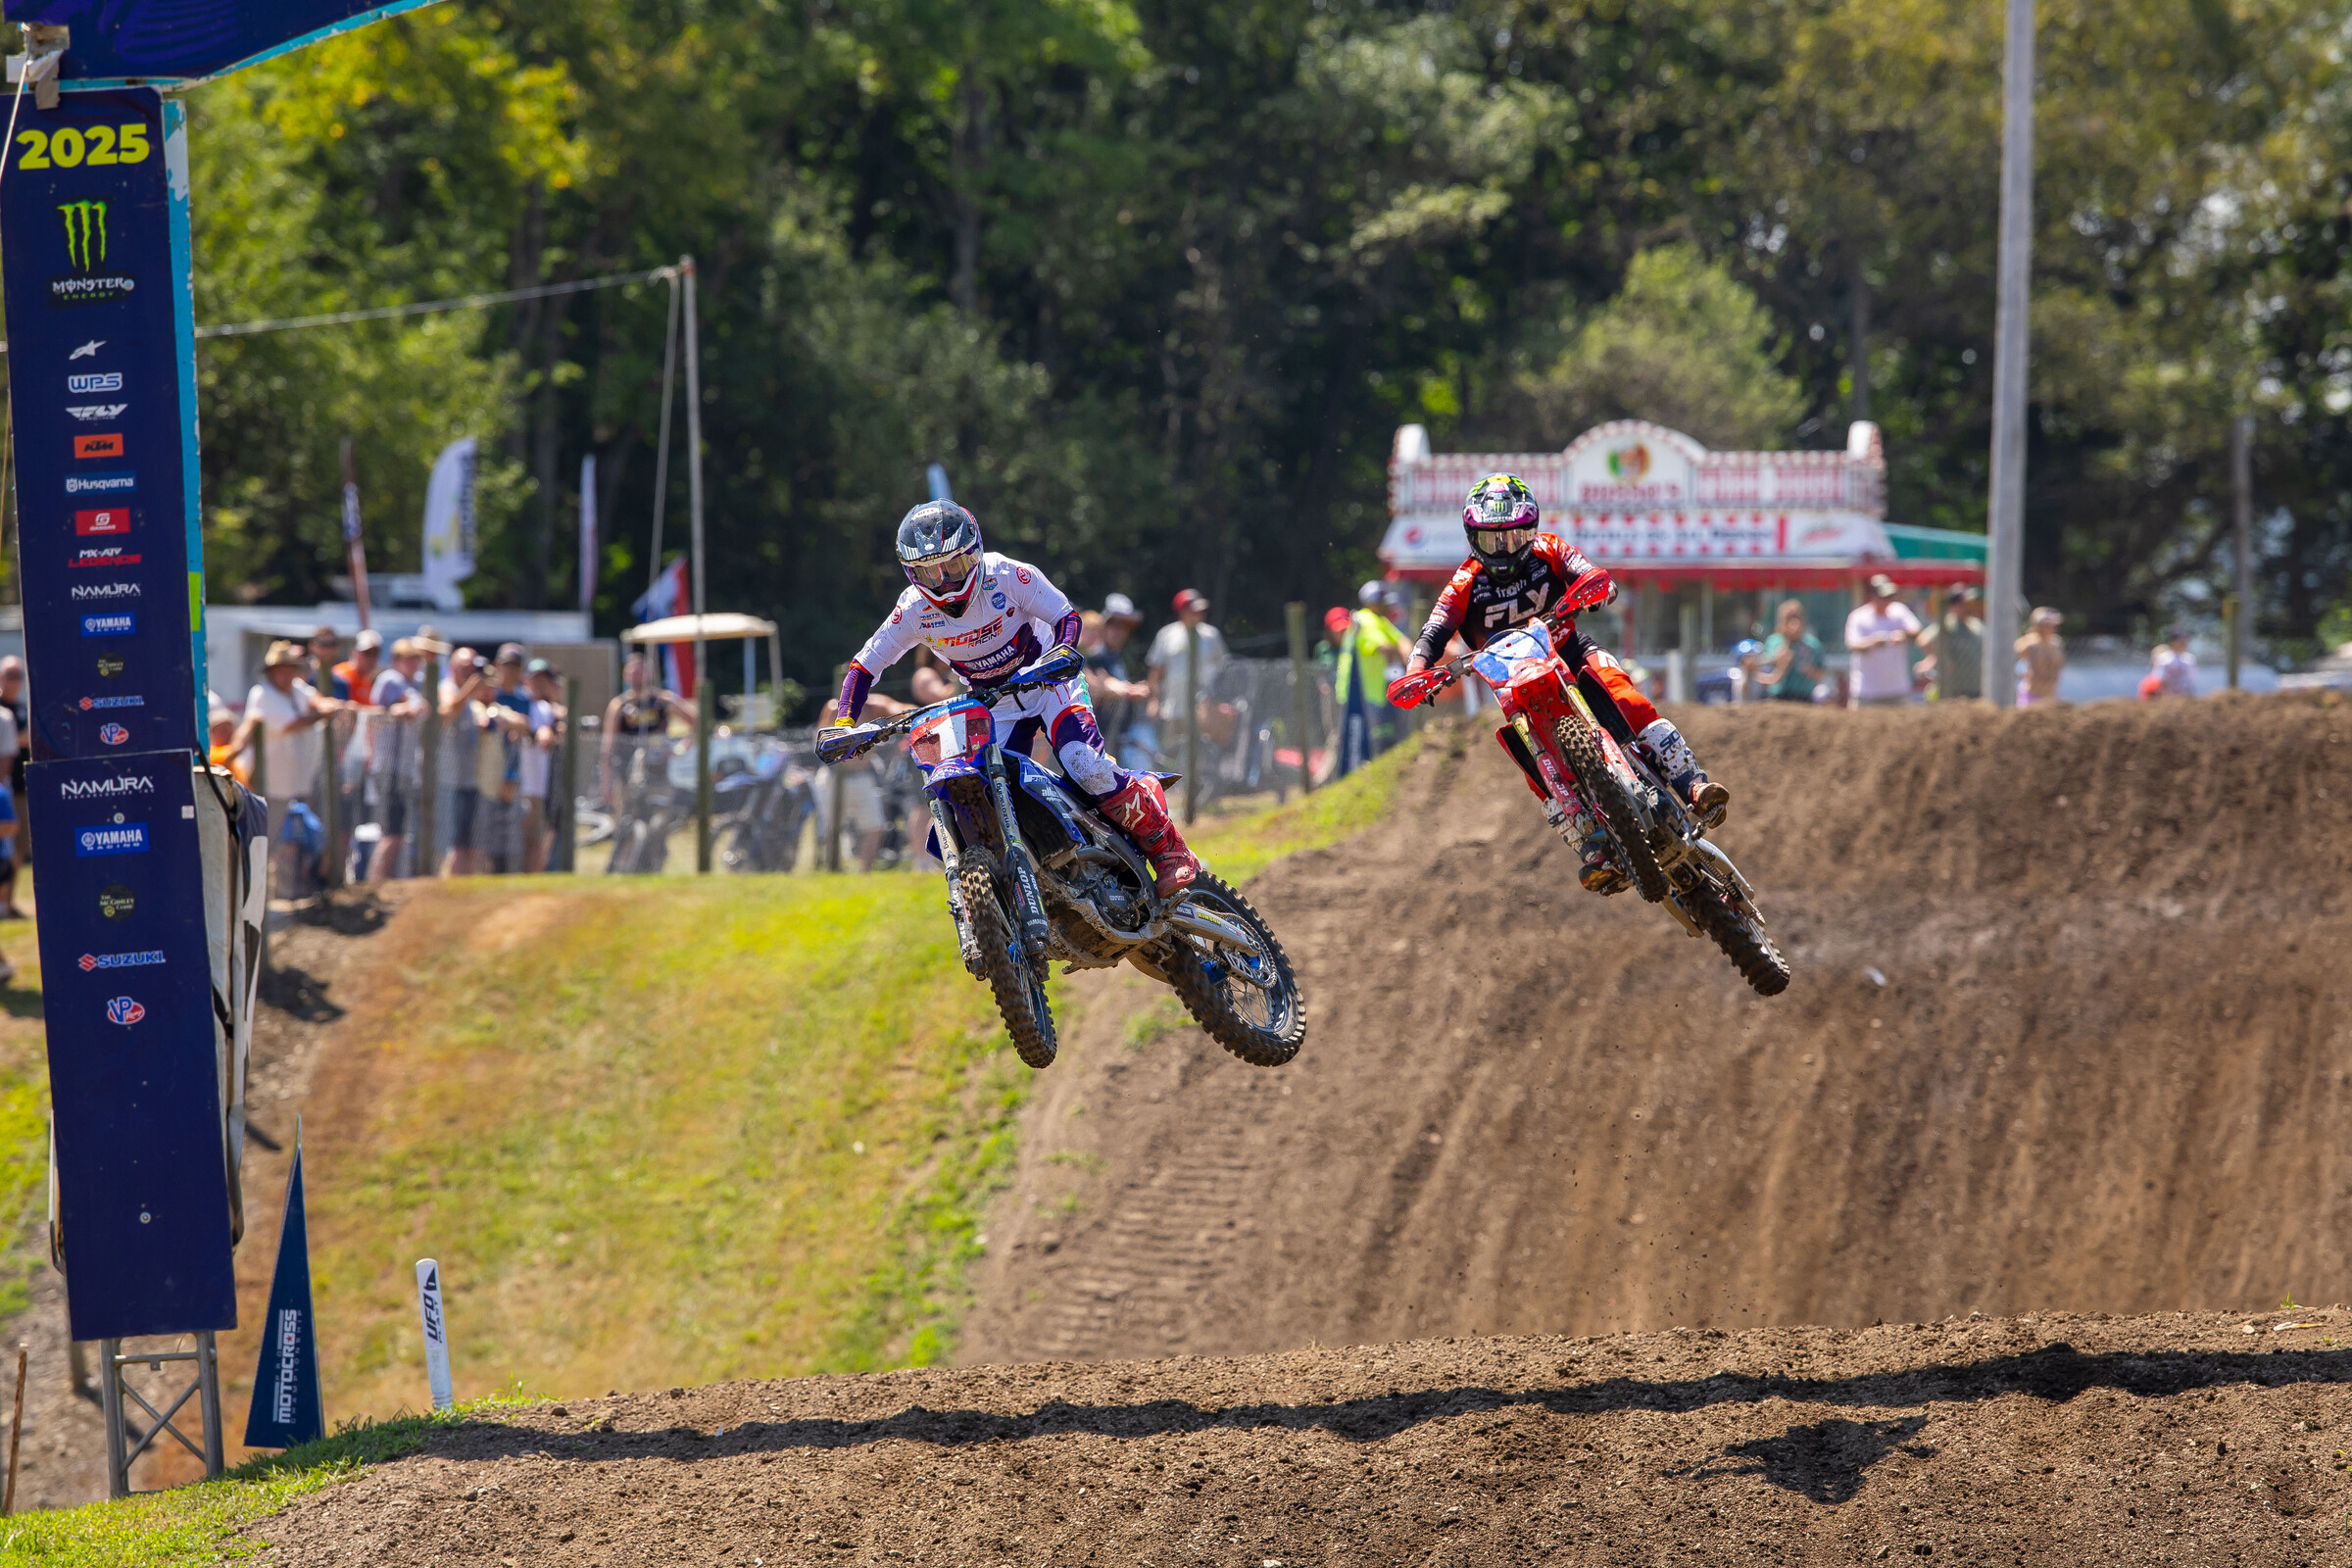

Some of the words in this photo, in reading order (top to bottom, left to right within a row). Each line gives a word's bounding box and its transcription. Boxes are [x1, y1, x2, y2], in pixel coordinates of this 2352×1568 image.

[16, 123, 150, 171] 2025
[53, 277, 126, 293] MONSTER
[70, 373, 122, 392] WPS
[66, 404, 128, 418] FLY
[84, 441, 115, 452] KTM
[78, 477, 134, 490] Husqvarna
[72, 582, 141, 598] NAMURA
[1484, 582, 1549, 628] FLY
[96, 616, 131, 629] YAMAHA
[937, 615, 1004, 648] MOOSE
[967, 627, 1004, 648] RACING
[975, 645, 1015, 668] YAMAHA
[101, 723, 121, 744] VP
[934, 712, 966, 761] 1
[61, 775, 153, 796] NAMURA
[95, 828, 143, 845] YAMAHA
[1017, 866, 1039, 914] DUNLOP
[98, 951, 166, 968] SUZUKI
[108, 997, 133, 1023] VP
[423, 1293, 438, 1341] UFO
[278, 1308, 298, 1424] MOTOCROSS
